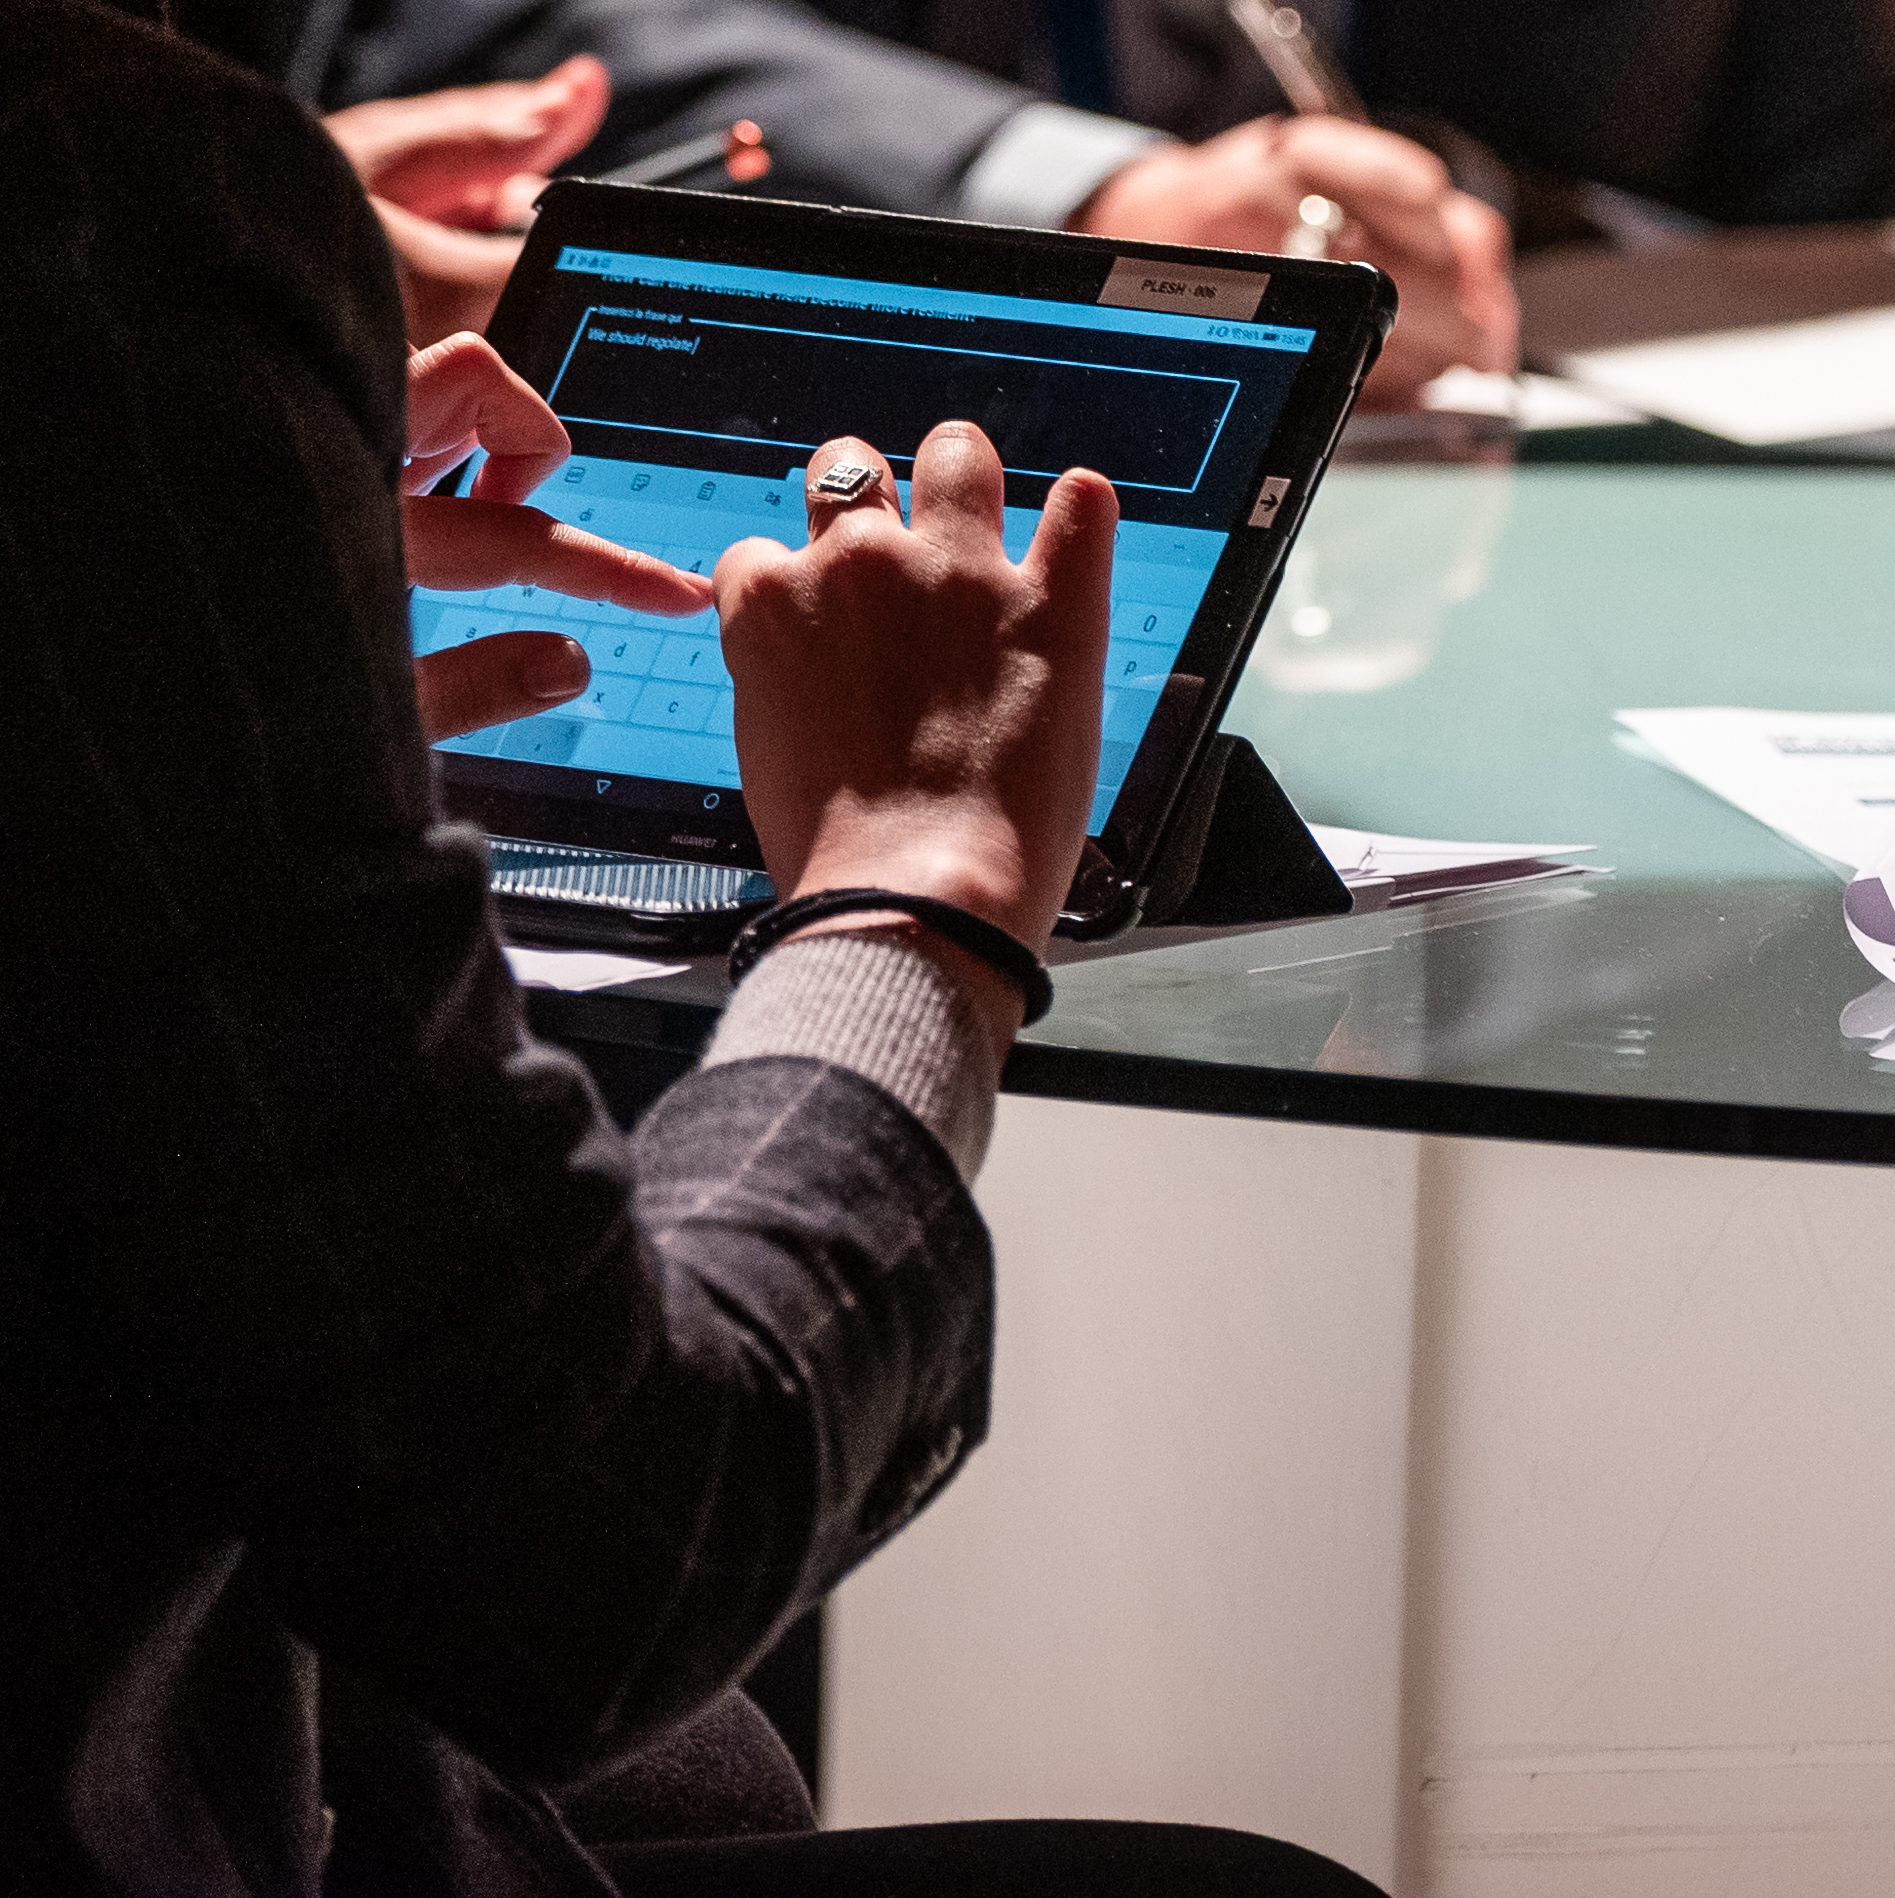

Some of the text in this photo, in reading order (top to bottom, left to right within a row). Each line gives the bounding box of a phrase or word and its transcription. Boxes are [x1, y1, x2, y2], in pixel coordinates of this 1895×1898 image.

[1141, 279, 1187, 296] PLESH
[588, 327, 607, 342] We
[607, 330, 646, 346] should
[614, 642, 627, 658] d
[689, 651, 701, 667] f
[1124, 659, 1137, 676] p
[668, 701, 679, 714] c
